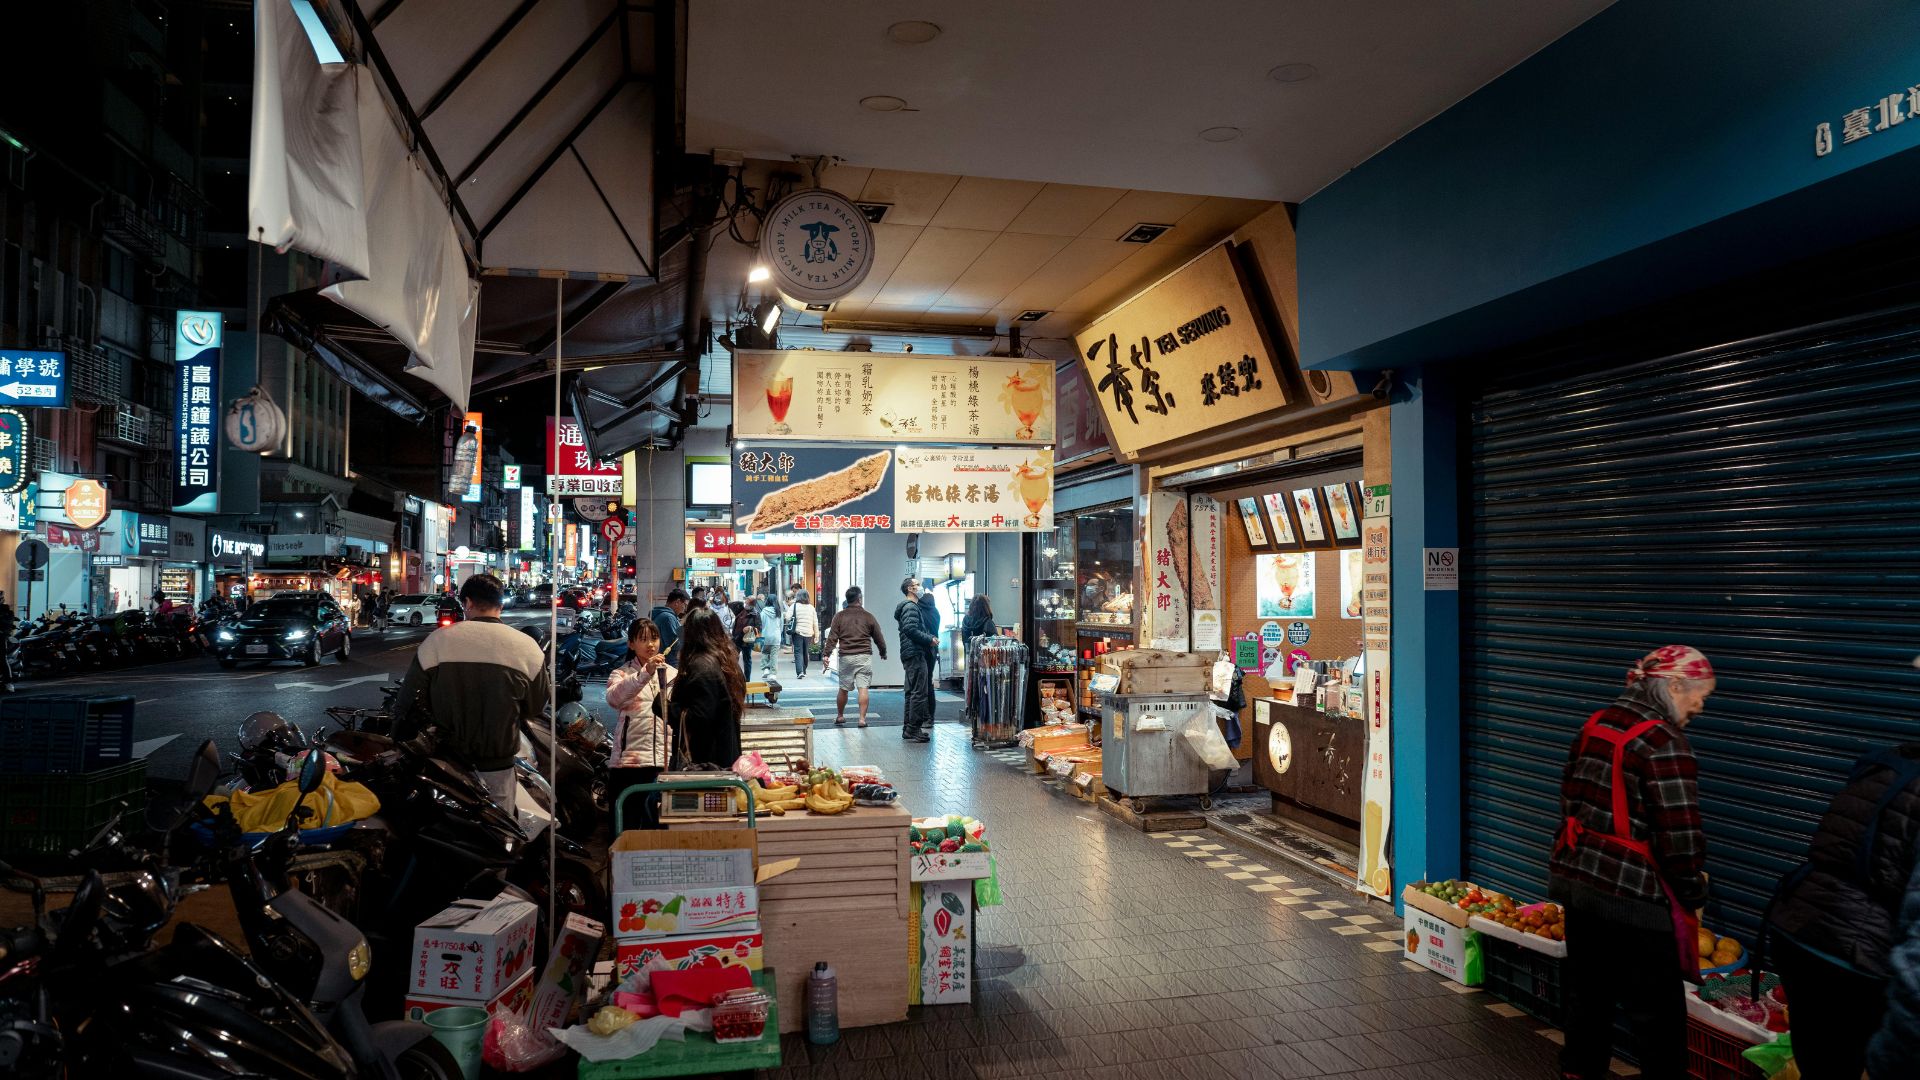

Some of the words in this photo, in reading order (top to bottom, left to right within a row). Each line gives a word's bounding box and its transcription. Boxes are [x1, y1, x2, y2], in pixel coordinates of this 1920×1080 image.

[782, 204, 806, 228] MILK
[809, 202, 830, 211] TEA
[834, 208, 860, 253] FACTORY
[777, 232, 802, 277] FACTORY
[832, 258, 855, 280] MILK
[807, 273, 829, 283] TEA
[1154, 331, 1181, 356] TEA
[1177, 306, 1231, 345] SERVING
[861, 362, 873, 416] 霜乳奶茶
[968, 365, 980, 436] 楊桃綠茶湯
[189, 365, 212, 487] 富興鐘錶公司
[739, 451, 795, 474] 豬大郎
[905, 483, 1001, 504] 楊桃綠茶湯
[1375, 499, 1385, 513] 61
[793, 515, 891, 530] 全台最大最好吃
[223, 540, 234, 554] THE
[1156, 547, 1172, 612] 豬大郎
[938, 946, 952, 994] 網室木瓜
[953, 946, 966, 992] 美濃名產
